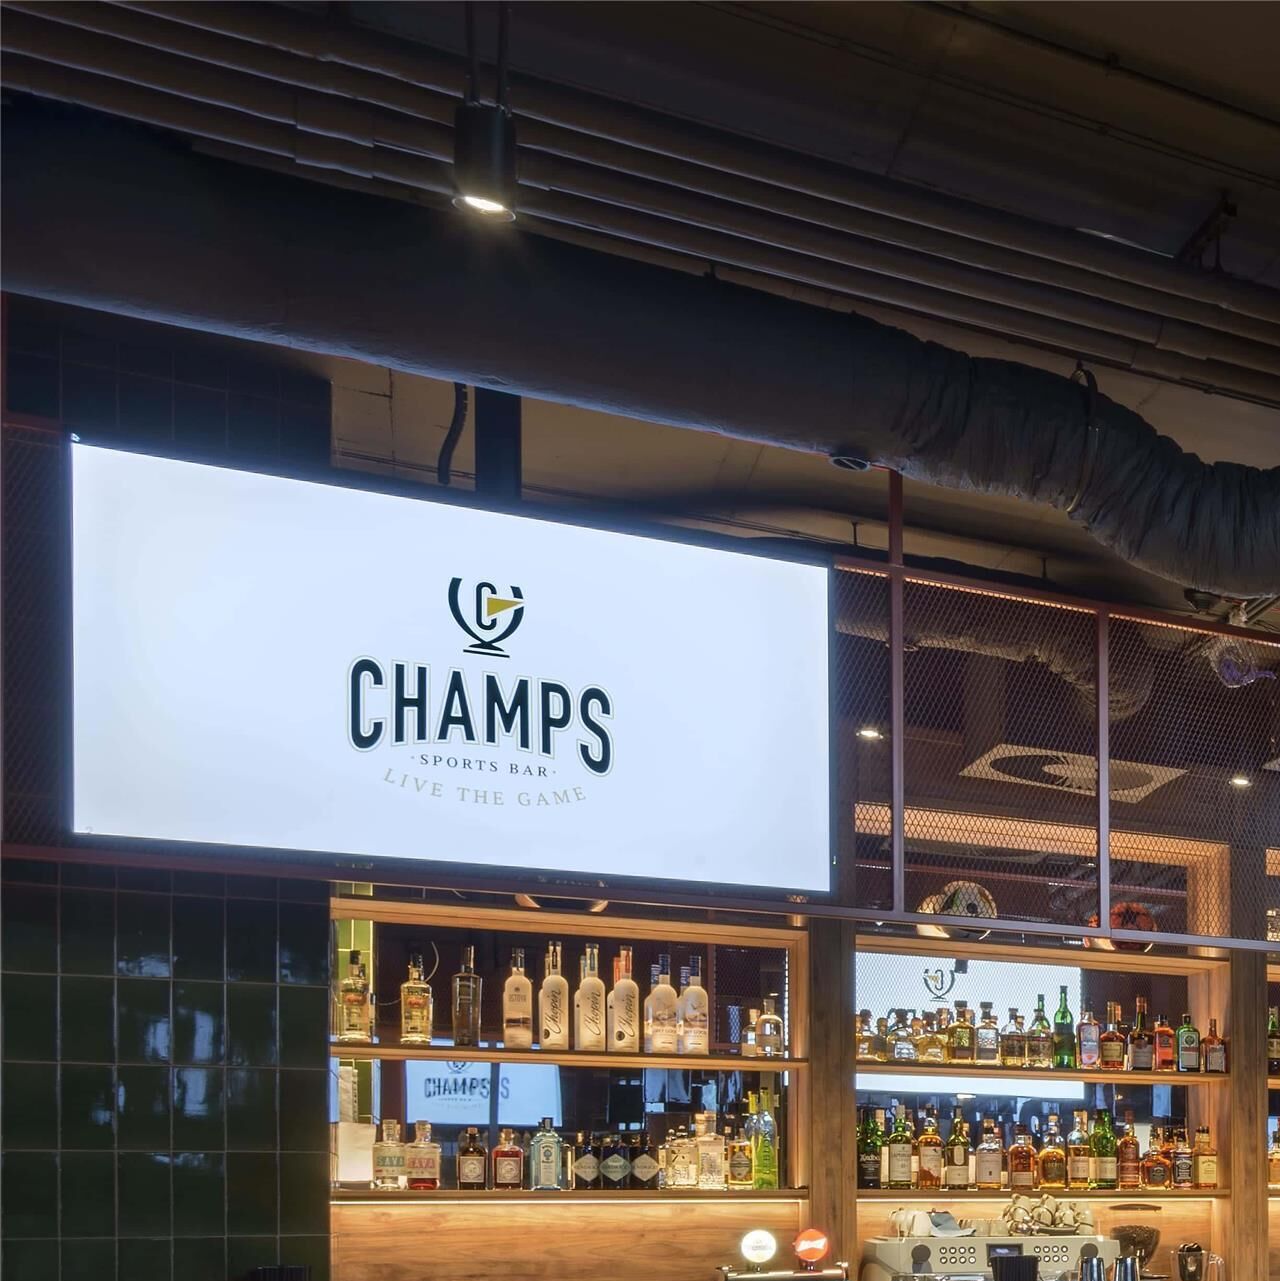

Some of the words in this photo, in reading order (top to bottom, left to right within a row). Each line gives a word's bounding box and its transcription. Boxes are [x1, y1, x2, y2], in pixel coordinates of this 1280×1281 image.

[350, 658, 613, 774] CHAMPS
[383, 768, 444, 797] LIVE
[457, 786, 504, 806] THE
[517, 786, 587, 807] GAME
[420, 753, 498, 772] SPORTS
[509, 762, 548, 777] BAR
[544, 989, 563, 1035] Chopin
[584, 989, 602, 1036] Chopin
[617, 991, 636, 1038] Chopin
